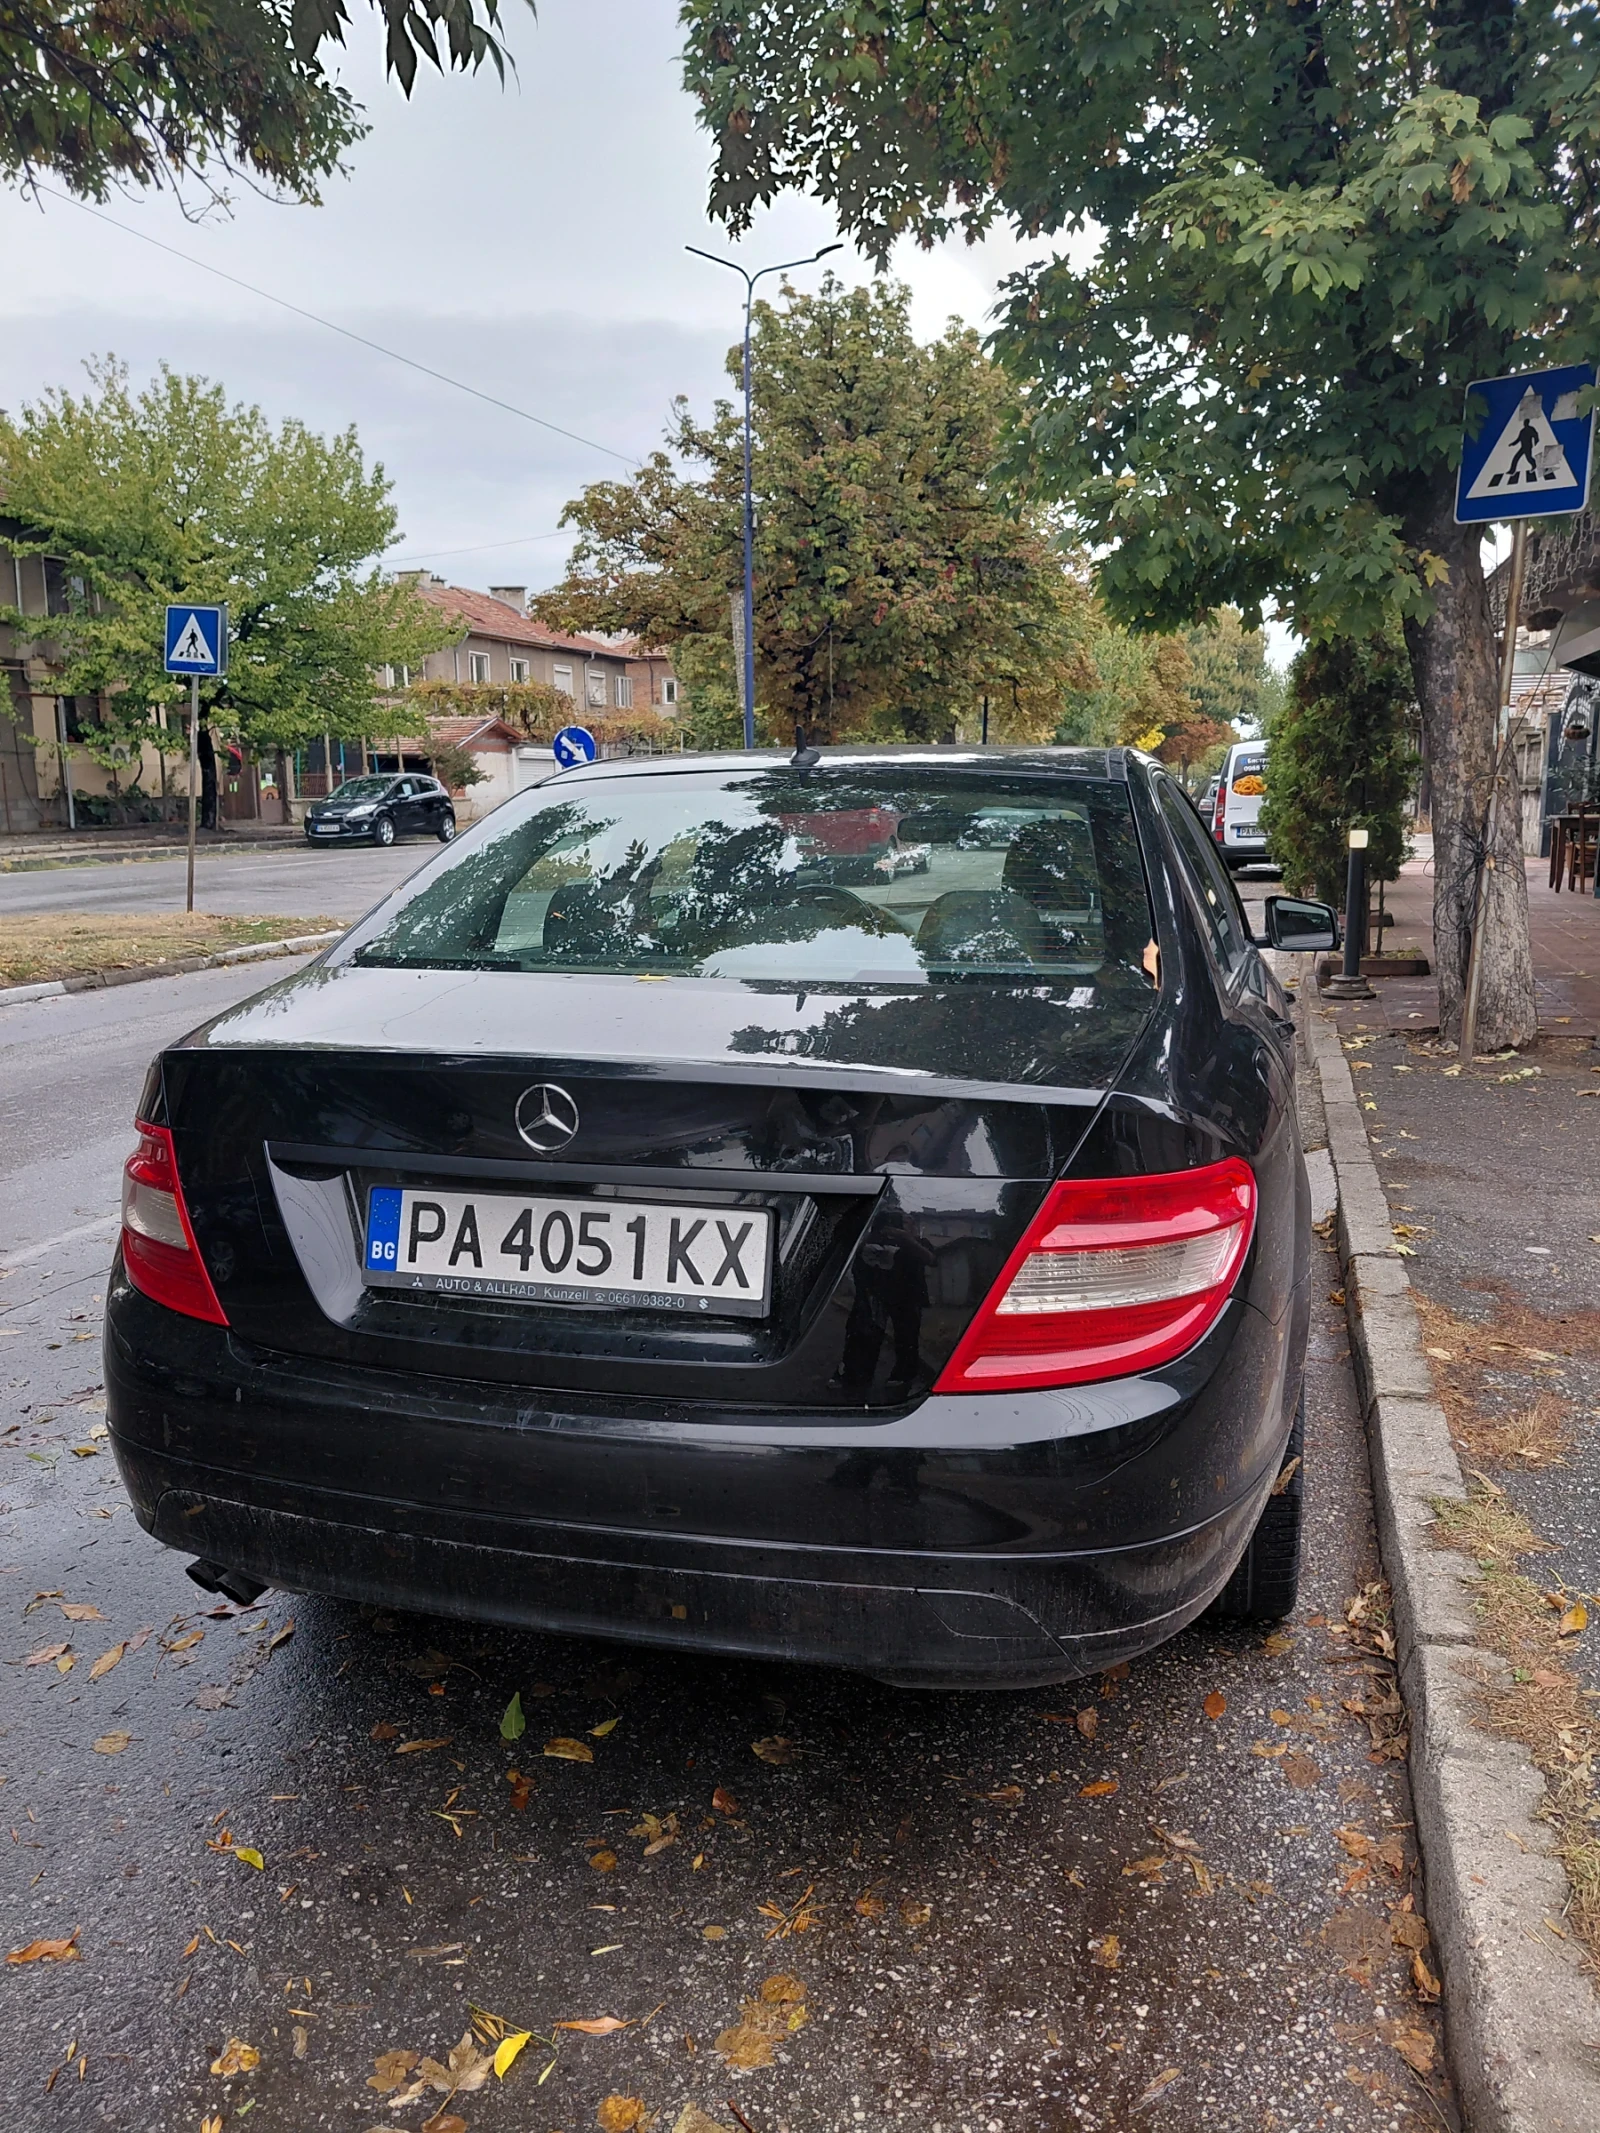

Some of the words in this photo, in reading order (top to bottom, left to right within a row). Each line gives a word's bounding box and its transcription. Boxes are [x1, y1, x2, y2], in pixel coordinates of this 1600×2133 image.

[371, 1240, 396, 1260] BG
[407, 1201, 483, 1268] PA
[500, 1208, 647, 1280] 4051
[666, 1217, 753, 1288] KX
[436, 1277, 471, 1292] AUTO
[474, 1281, 482, 1292] &
[485, 1282, 537, 1297] ALLRAD
[608, 1291, 685, 1308] 0661/9382-0
